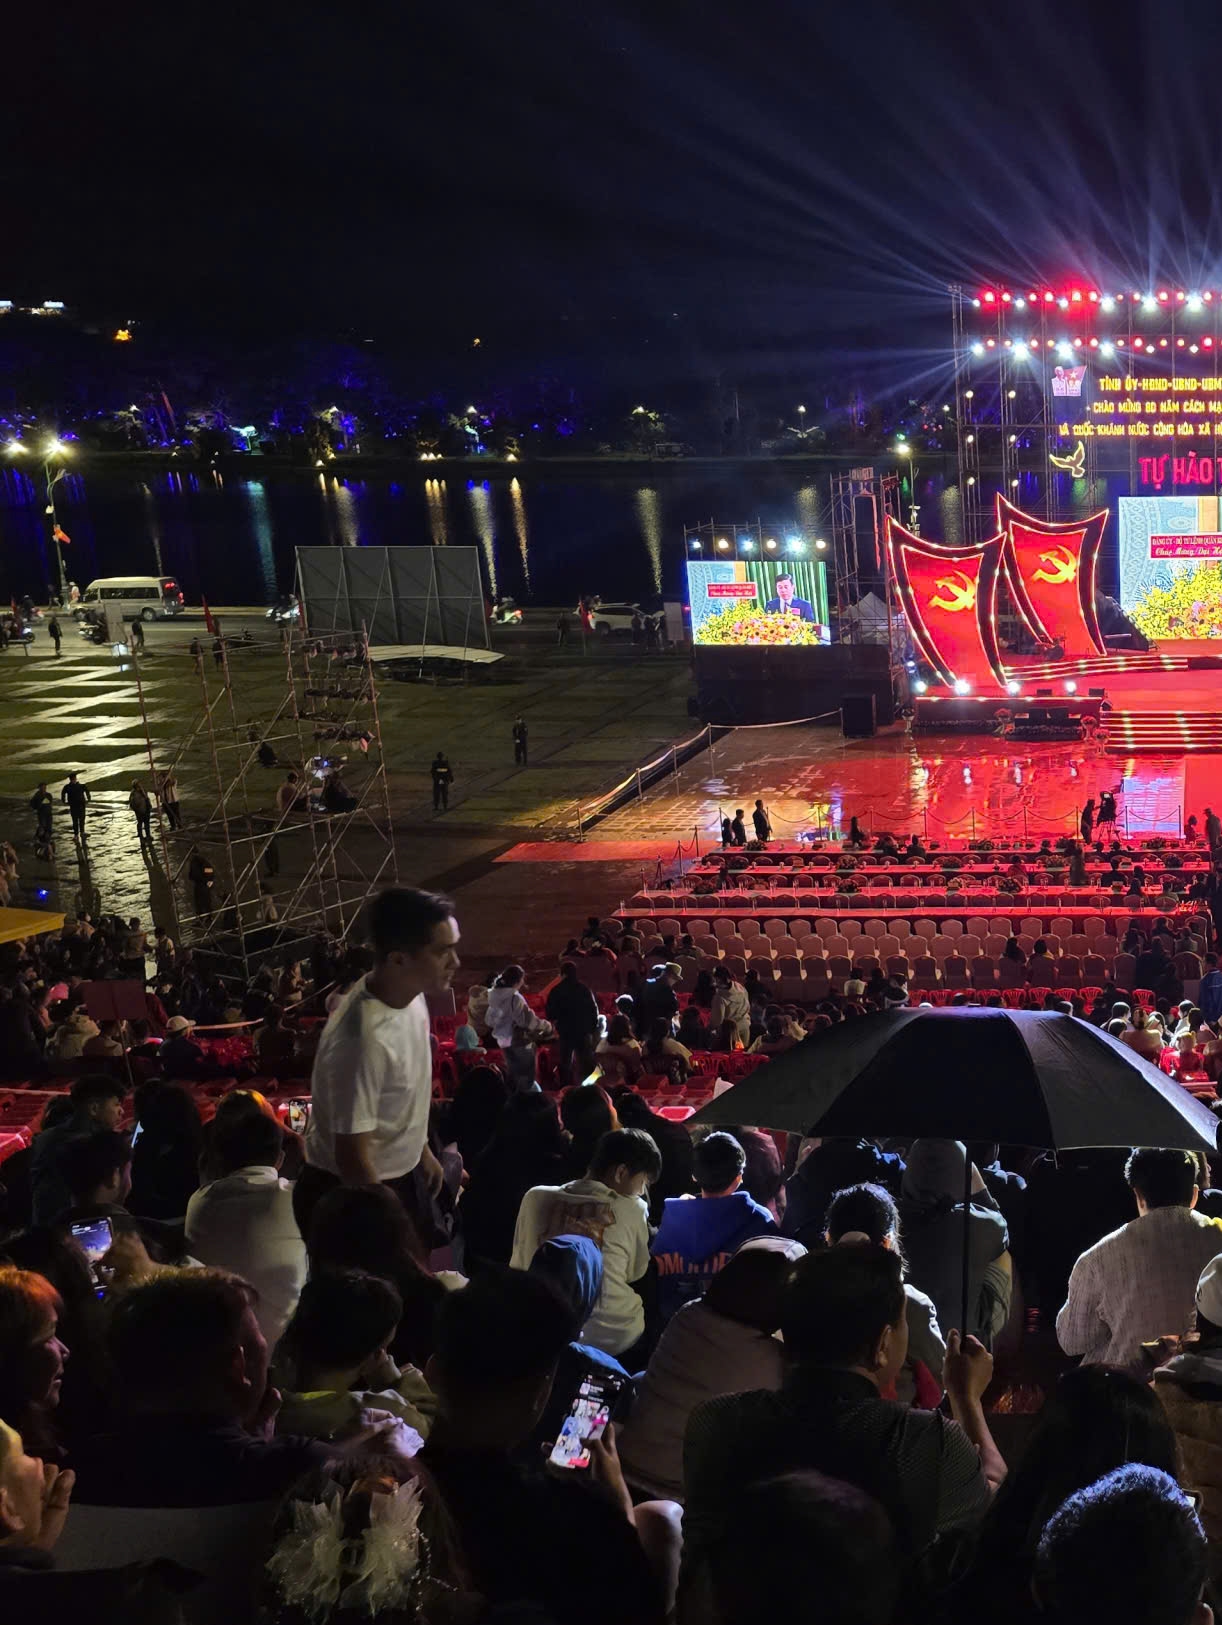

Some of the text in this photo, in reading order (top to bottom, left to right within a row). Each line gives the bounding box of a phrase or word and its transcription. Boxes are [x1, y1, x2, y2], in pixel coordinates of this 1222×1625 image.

[1093, 399, 1114, 413] CHÀO
[1145, 402, 1156, 413] 80
[1160, 399, 1180, 413] NĂM
[1183, 399, 1205, 413] CÁCH
[1153, 421, 1175, 437] CỘNG
[1199, 421, 1211, 435] XÃ
[1138, 453, 1170, 490] TỰ
[1173, 450, 1214, 485] HÀO
